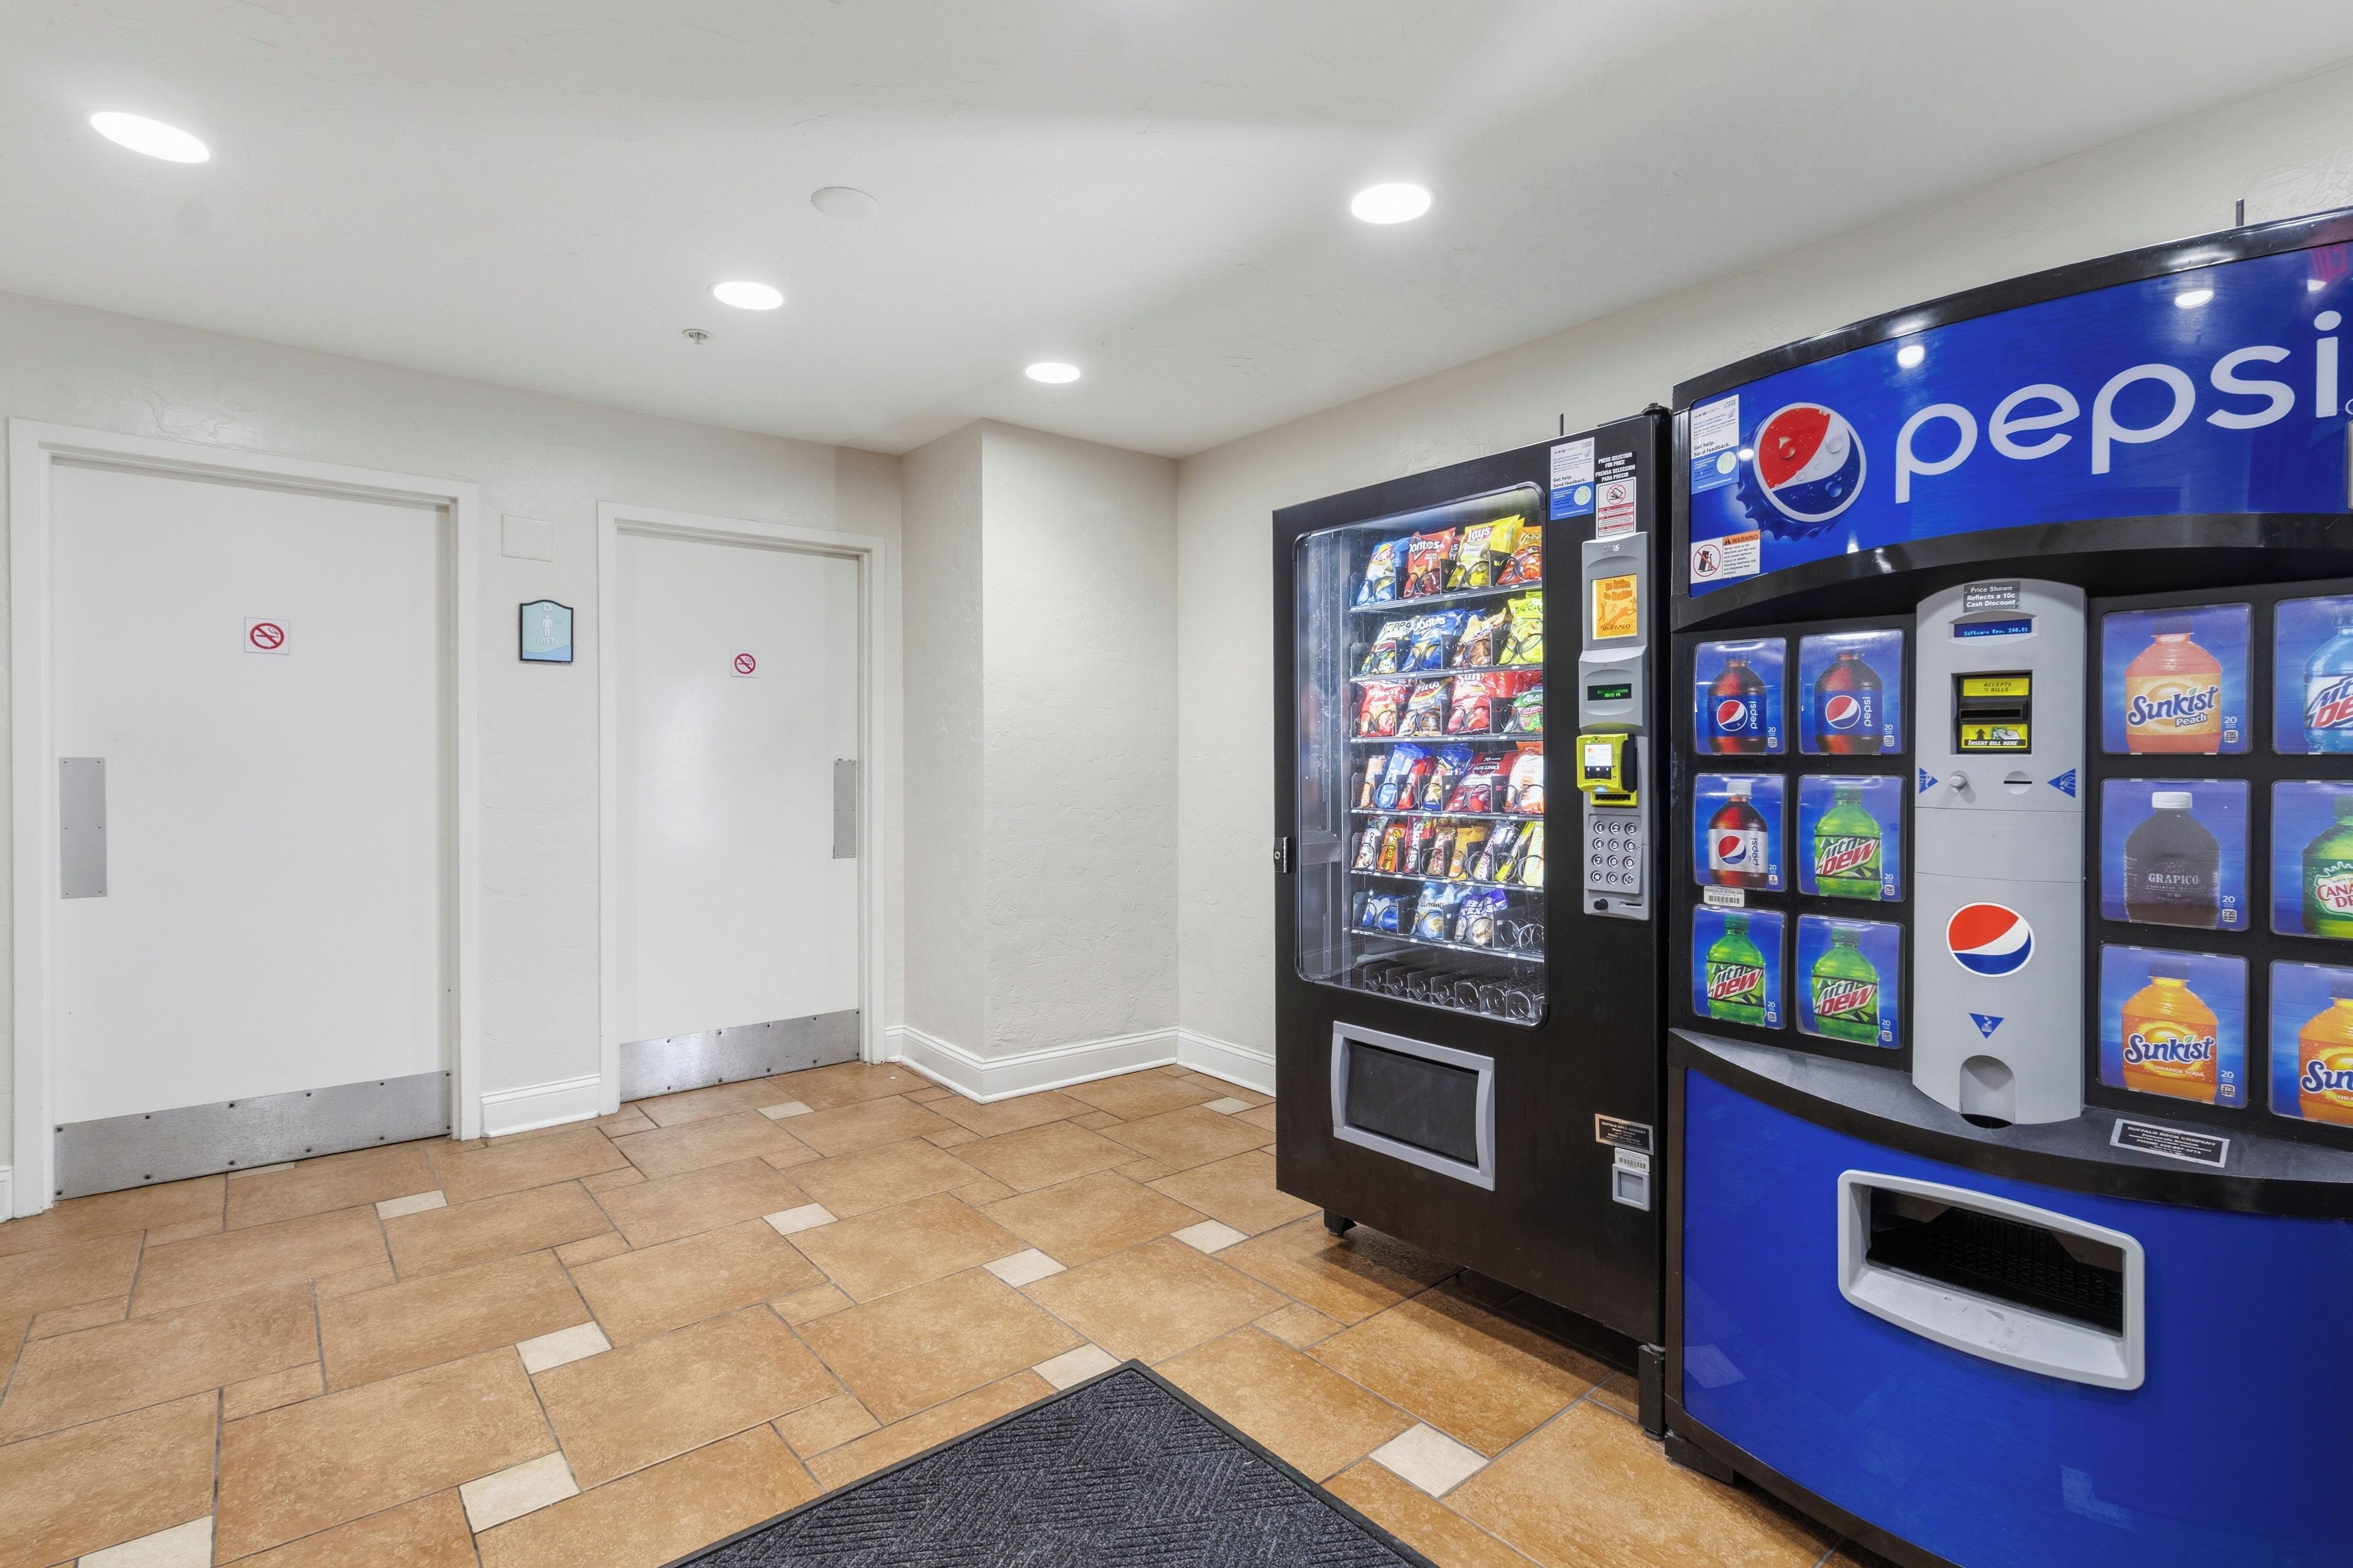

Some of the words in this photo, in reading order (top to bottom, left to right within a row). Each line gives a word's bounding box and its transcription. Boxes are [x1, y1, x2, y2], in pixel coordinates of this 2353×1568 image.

[1895, 310, 2343, 504] pepsi
[1707, 442, 1731, 452] feedback.
[1612, 452, 1632, 461] SELECTION
[1612, 464, 1635, 474] SELECCION
[1467, 527, 1491, 543] Lay's
[1732, 534, 1759, 543] WARNING
[1862, 697, 1873, 727] pepsi
[2128, 685, 2219, 725] Sunkist
[1749, 701, 1758, 729] pepsi
[2176, 713, 2207, 727] Peach
[1751, 838, 1759, 866] pepsi
[1824, 838, 1857, 858] Mtn
[1823, 840, 1877, 876] Dew
[2148, 873, 2199, 885] GRAPICO
[1461, 904, 1494, 916] TEXAS
[1715, 969, 1763, 999] Dew
[1716, 966, 1744, 984] Mtn
[1823, 982, 1855, 1000] Mtn
[1821, 985, 1875, 1016] Dew
[2124, 1033, 2215, 1064] Sunkist
[2154, 1066, 2183, 1074] ORANGE
[2221, 1070, 2234, 1079] 20
[2128, 1126, 2158, 1135] BUFFALO
[2181, 1137, 2216, 1146] COMPANY
